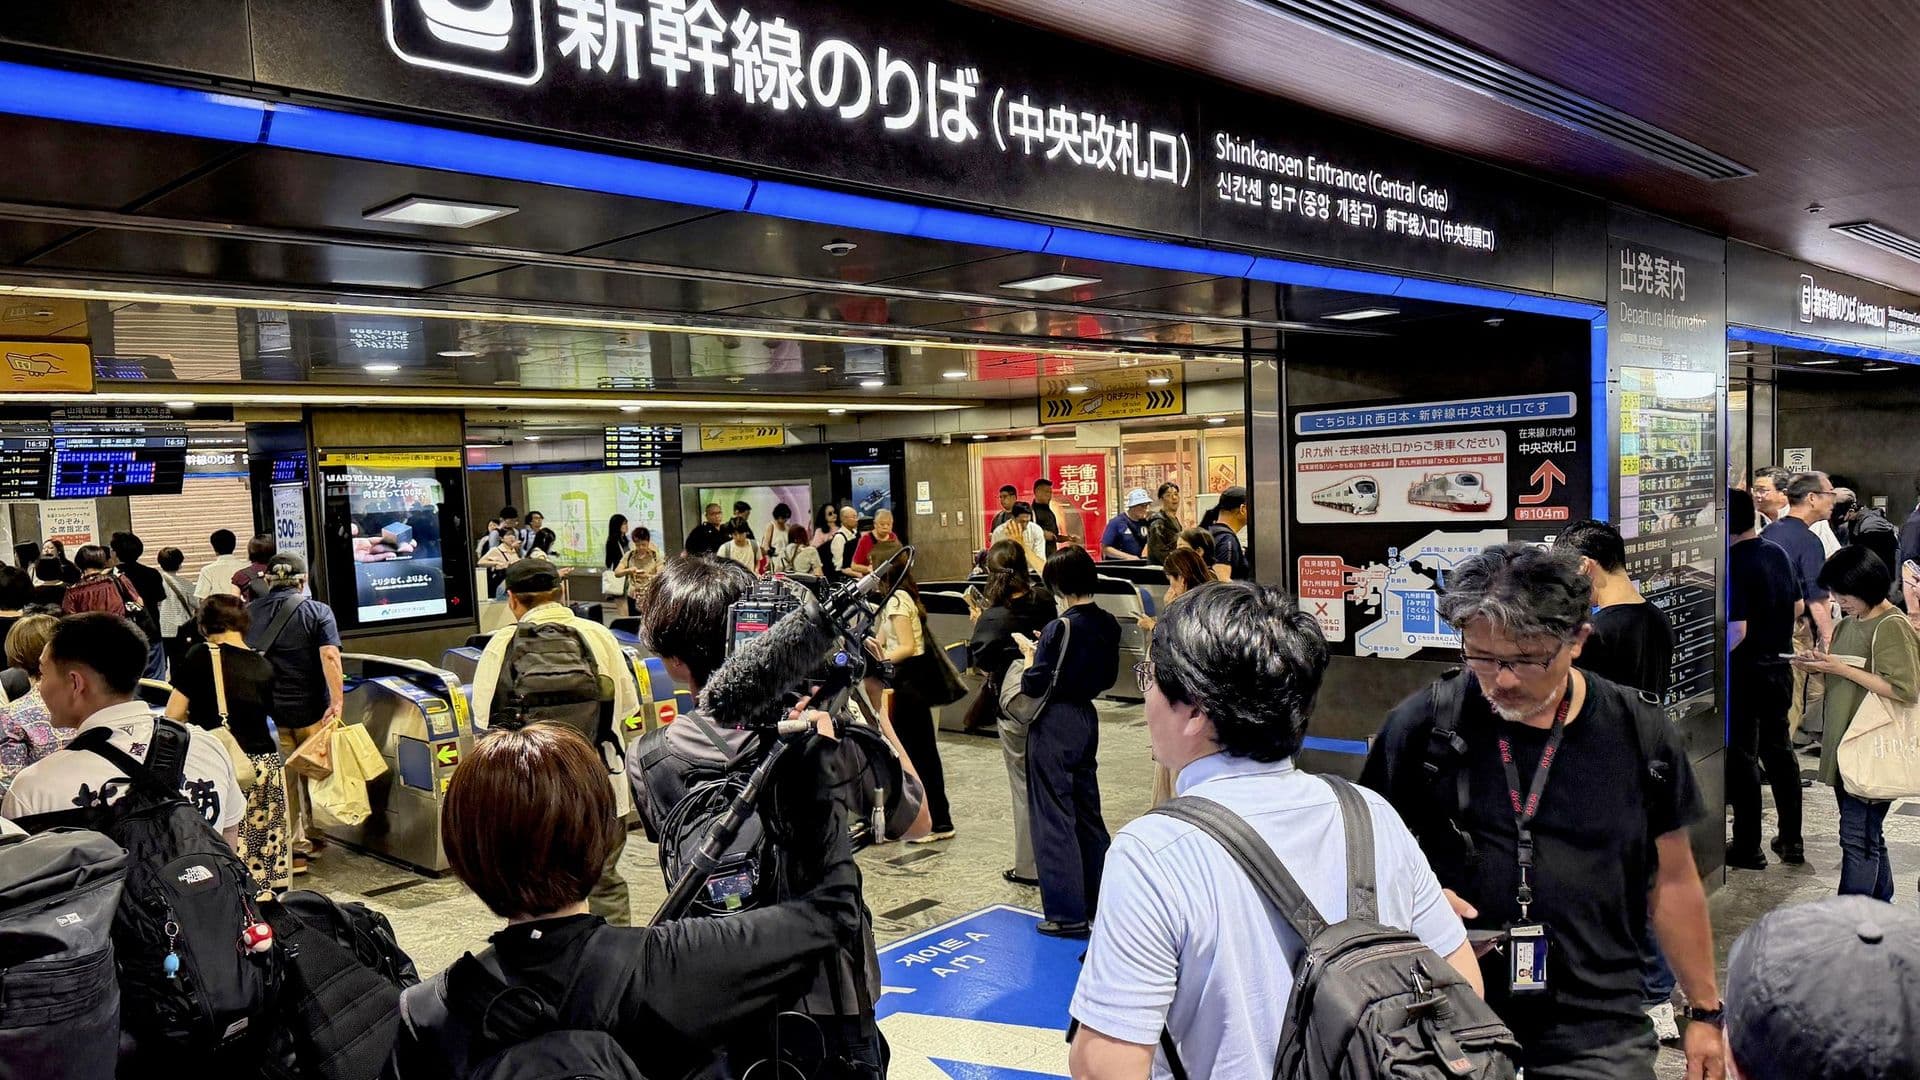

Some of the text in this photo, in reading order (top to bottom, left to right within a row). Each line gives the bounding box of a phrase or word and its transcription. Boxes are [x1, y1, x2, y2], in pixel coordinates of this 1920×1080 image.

[556, 0, 1191, 188] 新幹線のりば (中央改札口)
[1216, 132, 1303, 179] Shinkansen
[1418, 184, 1449, 213] Gate)
[1217, 171, 1378, 230] 신칸센 입구(중앙 개찰구)
[1620, 248, 1686, 302] 出発案内
[1620, 302, 1708, 331] Departure Information
[1315, 401, 1549, 429] こちらはJR西日本・新幹線中央改札口です
[1518, 426, 1576, 439] 在来線(JR九州)
[1300, 437, 1500, 459] JR九州・在来線改札口からご乗車ください
[1518, 440, 1577, 455] 中央改札口
[1060, 464, 1080, 502] 幸福。
[1079, 463, 1100, 517] 衝動と、
[1519, 507, 1566, 519] 約104m
[277, 518, 294, 539] 500
